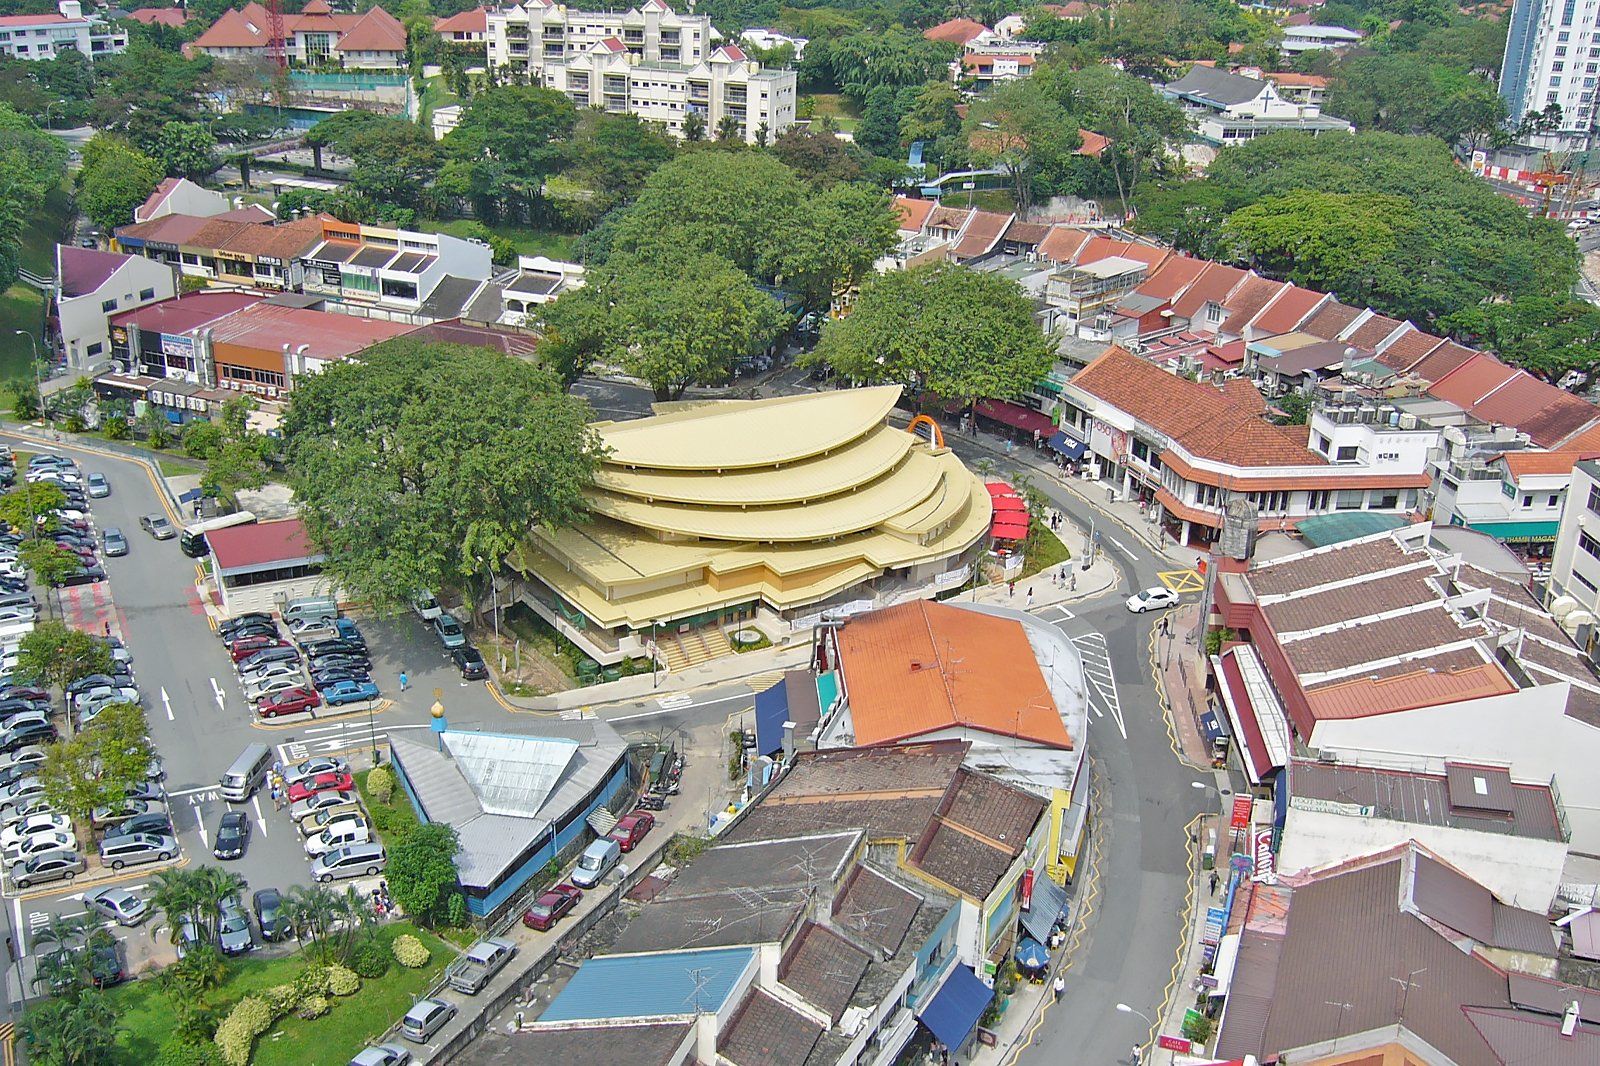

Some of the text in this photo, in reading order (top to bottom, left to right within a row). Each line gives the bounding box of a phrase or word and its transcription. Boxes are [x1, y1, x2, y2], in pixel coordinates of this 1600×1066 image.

[1063, 437, 1078, 449] VISA
[289, 744, 309, 759] STOP
[189, 791, 220, 805] WAY
[29, 911, 50, 935] STOP
